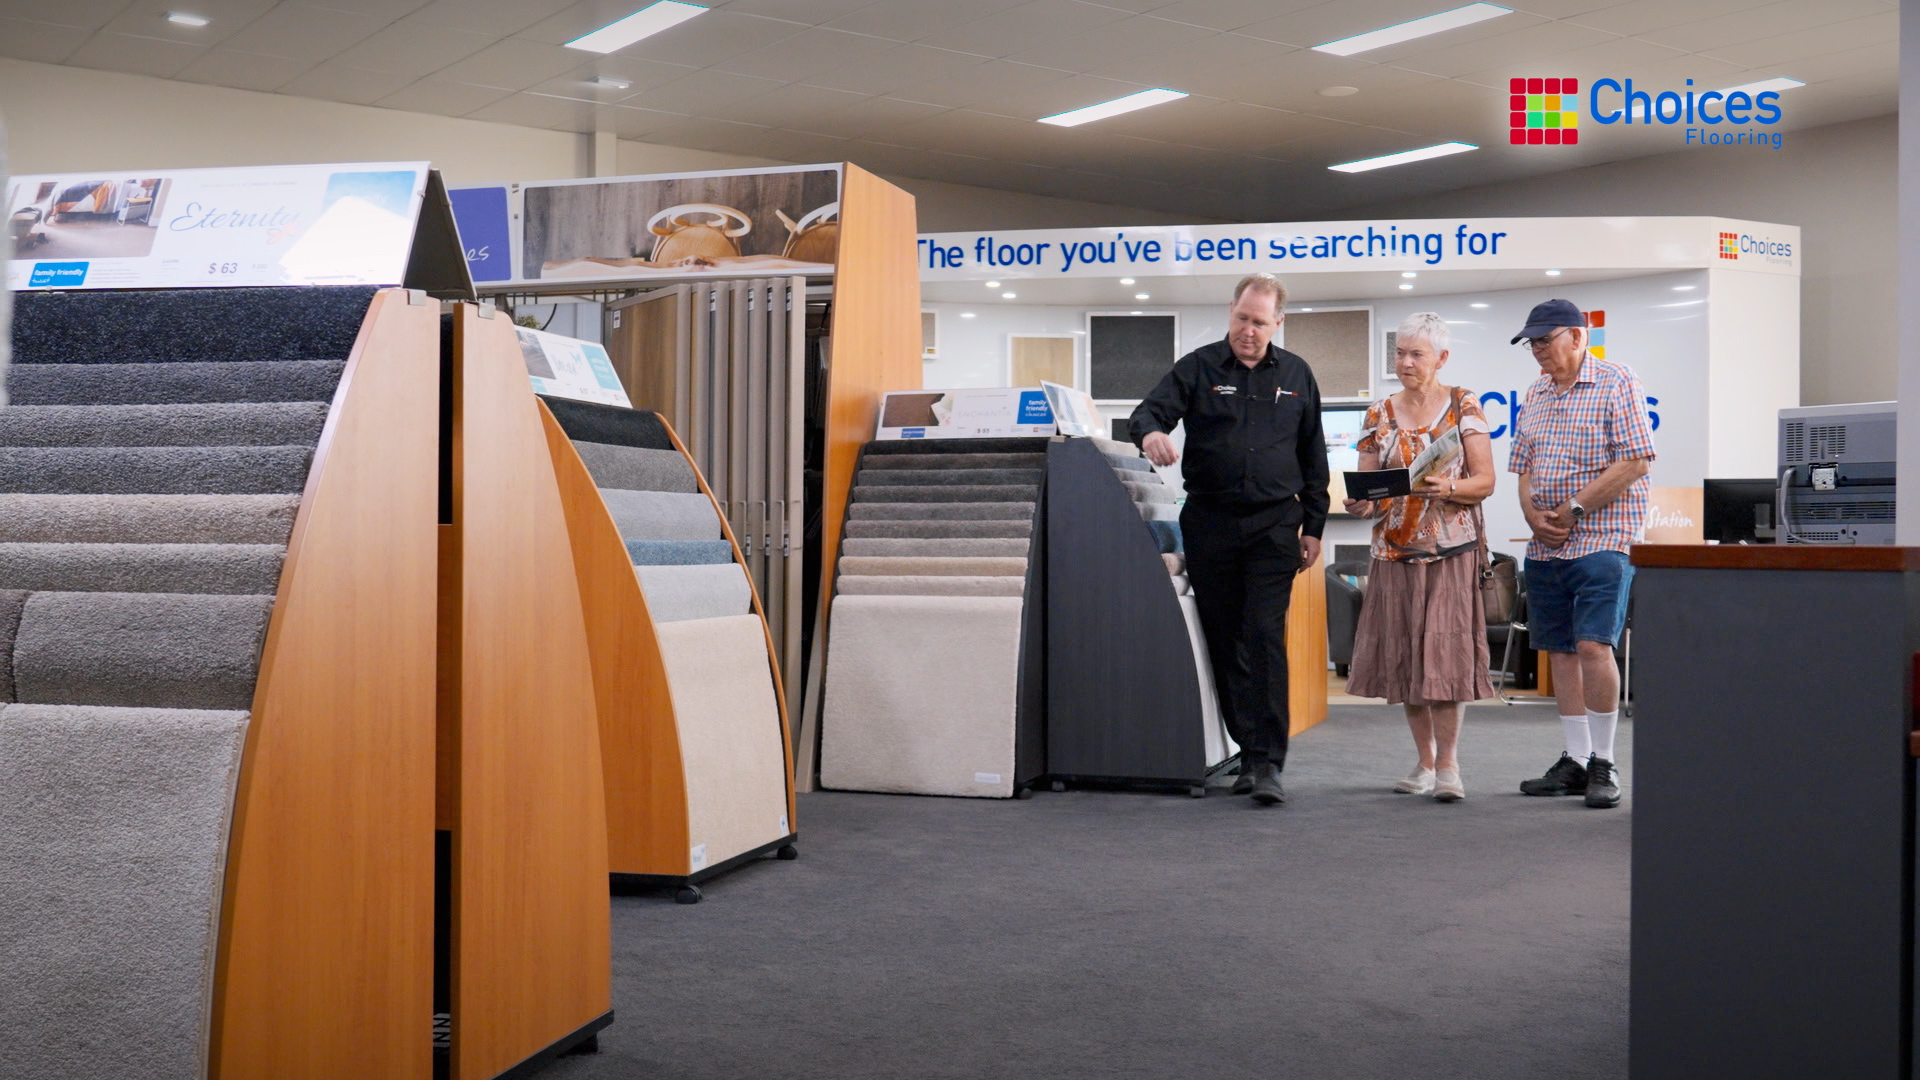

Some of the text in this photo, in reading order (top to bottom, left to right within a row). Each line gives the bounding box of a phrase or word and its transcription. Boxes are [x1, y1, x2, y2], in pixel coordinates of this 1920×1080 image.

[169, 201, 302, 245] Eternity
[917, 224, 1507, 272] The floor you've been searching for
[1740, 234, 1792, 257] Choices
[34, 268, 56, 277] family
[56, 267, 84, 277] friendly
[208, 262, 238, 274] $ 63
[1647, 506, 1695, 529] Station
